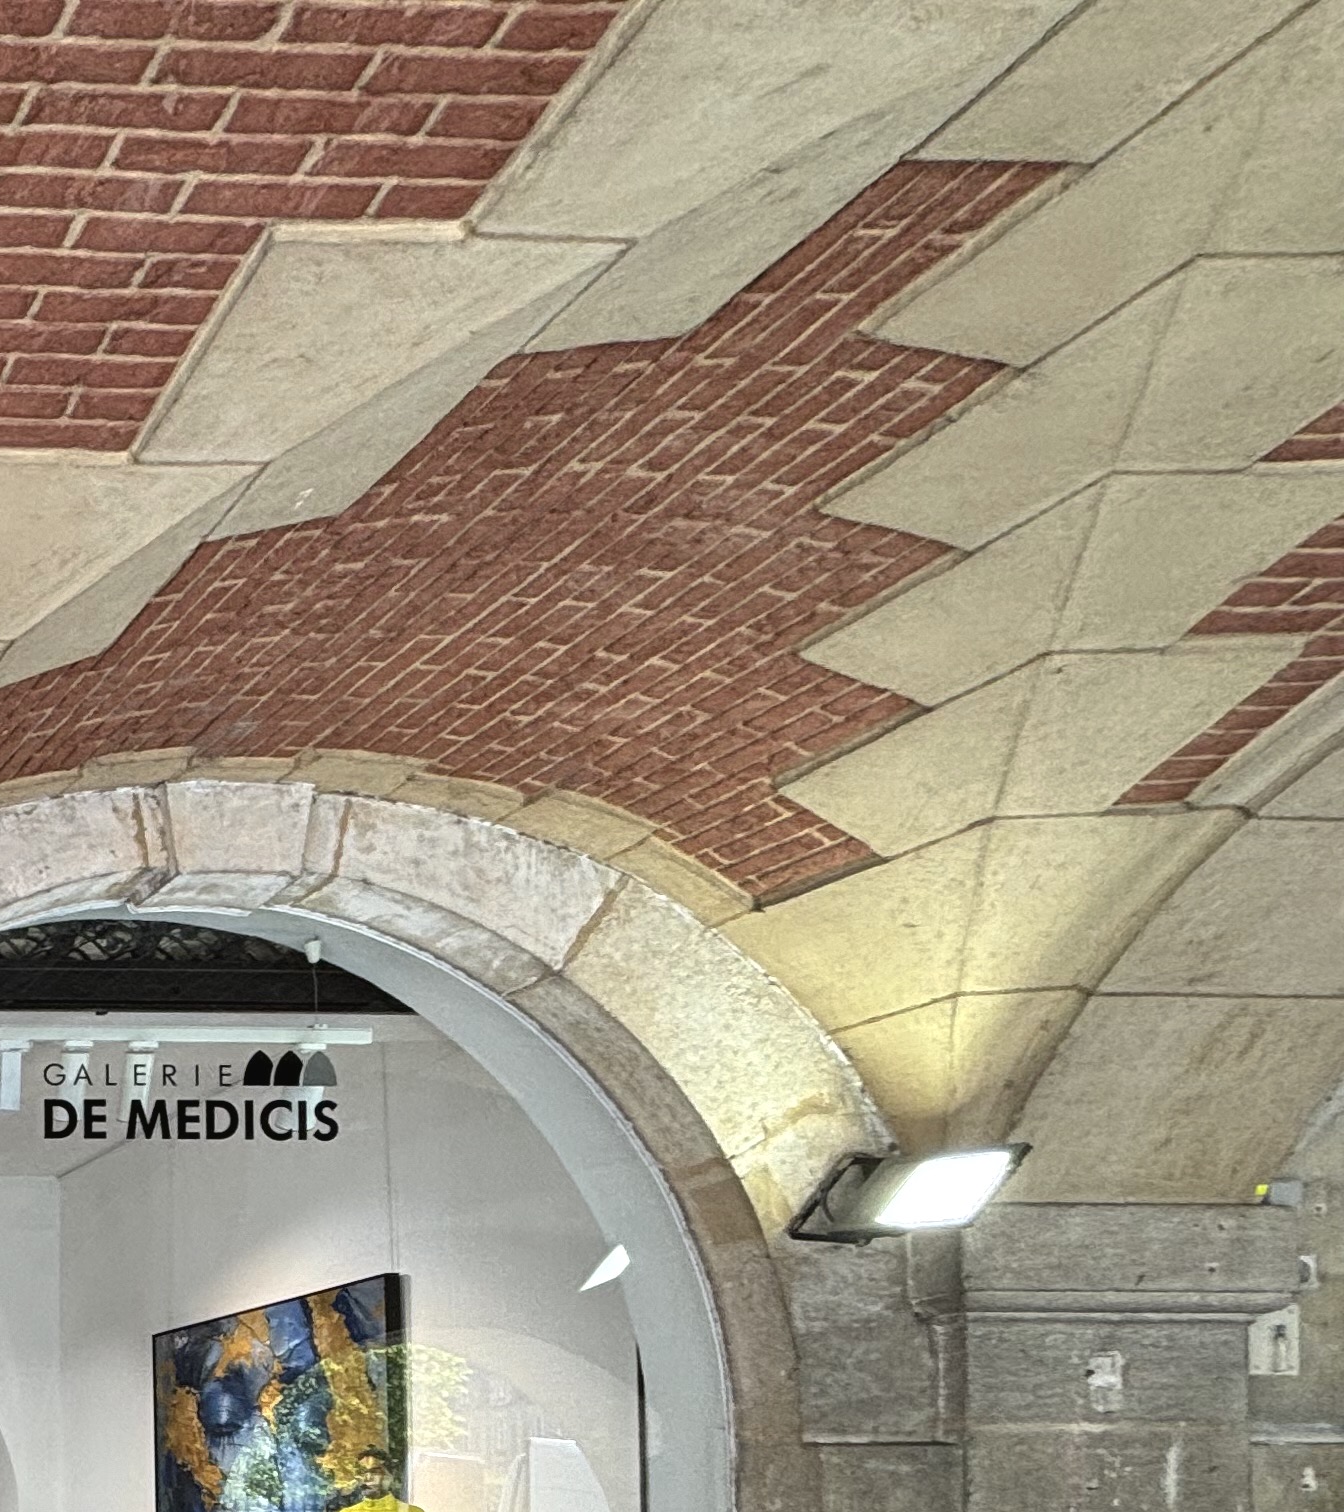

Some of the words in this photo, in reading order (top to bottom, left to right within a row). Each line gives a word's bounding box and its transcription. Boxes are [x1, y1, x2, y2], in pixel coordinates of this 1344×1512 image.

[43, 1063, 233, 1086] GALERIE
[44, 1099, 107, 1140] DE
[125, 1099, 339, 1141] MEDICIS
